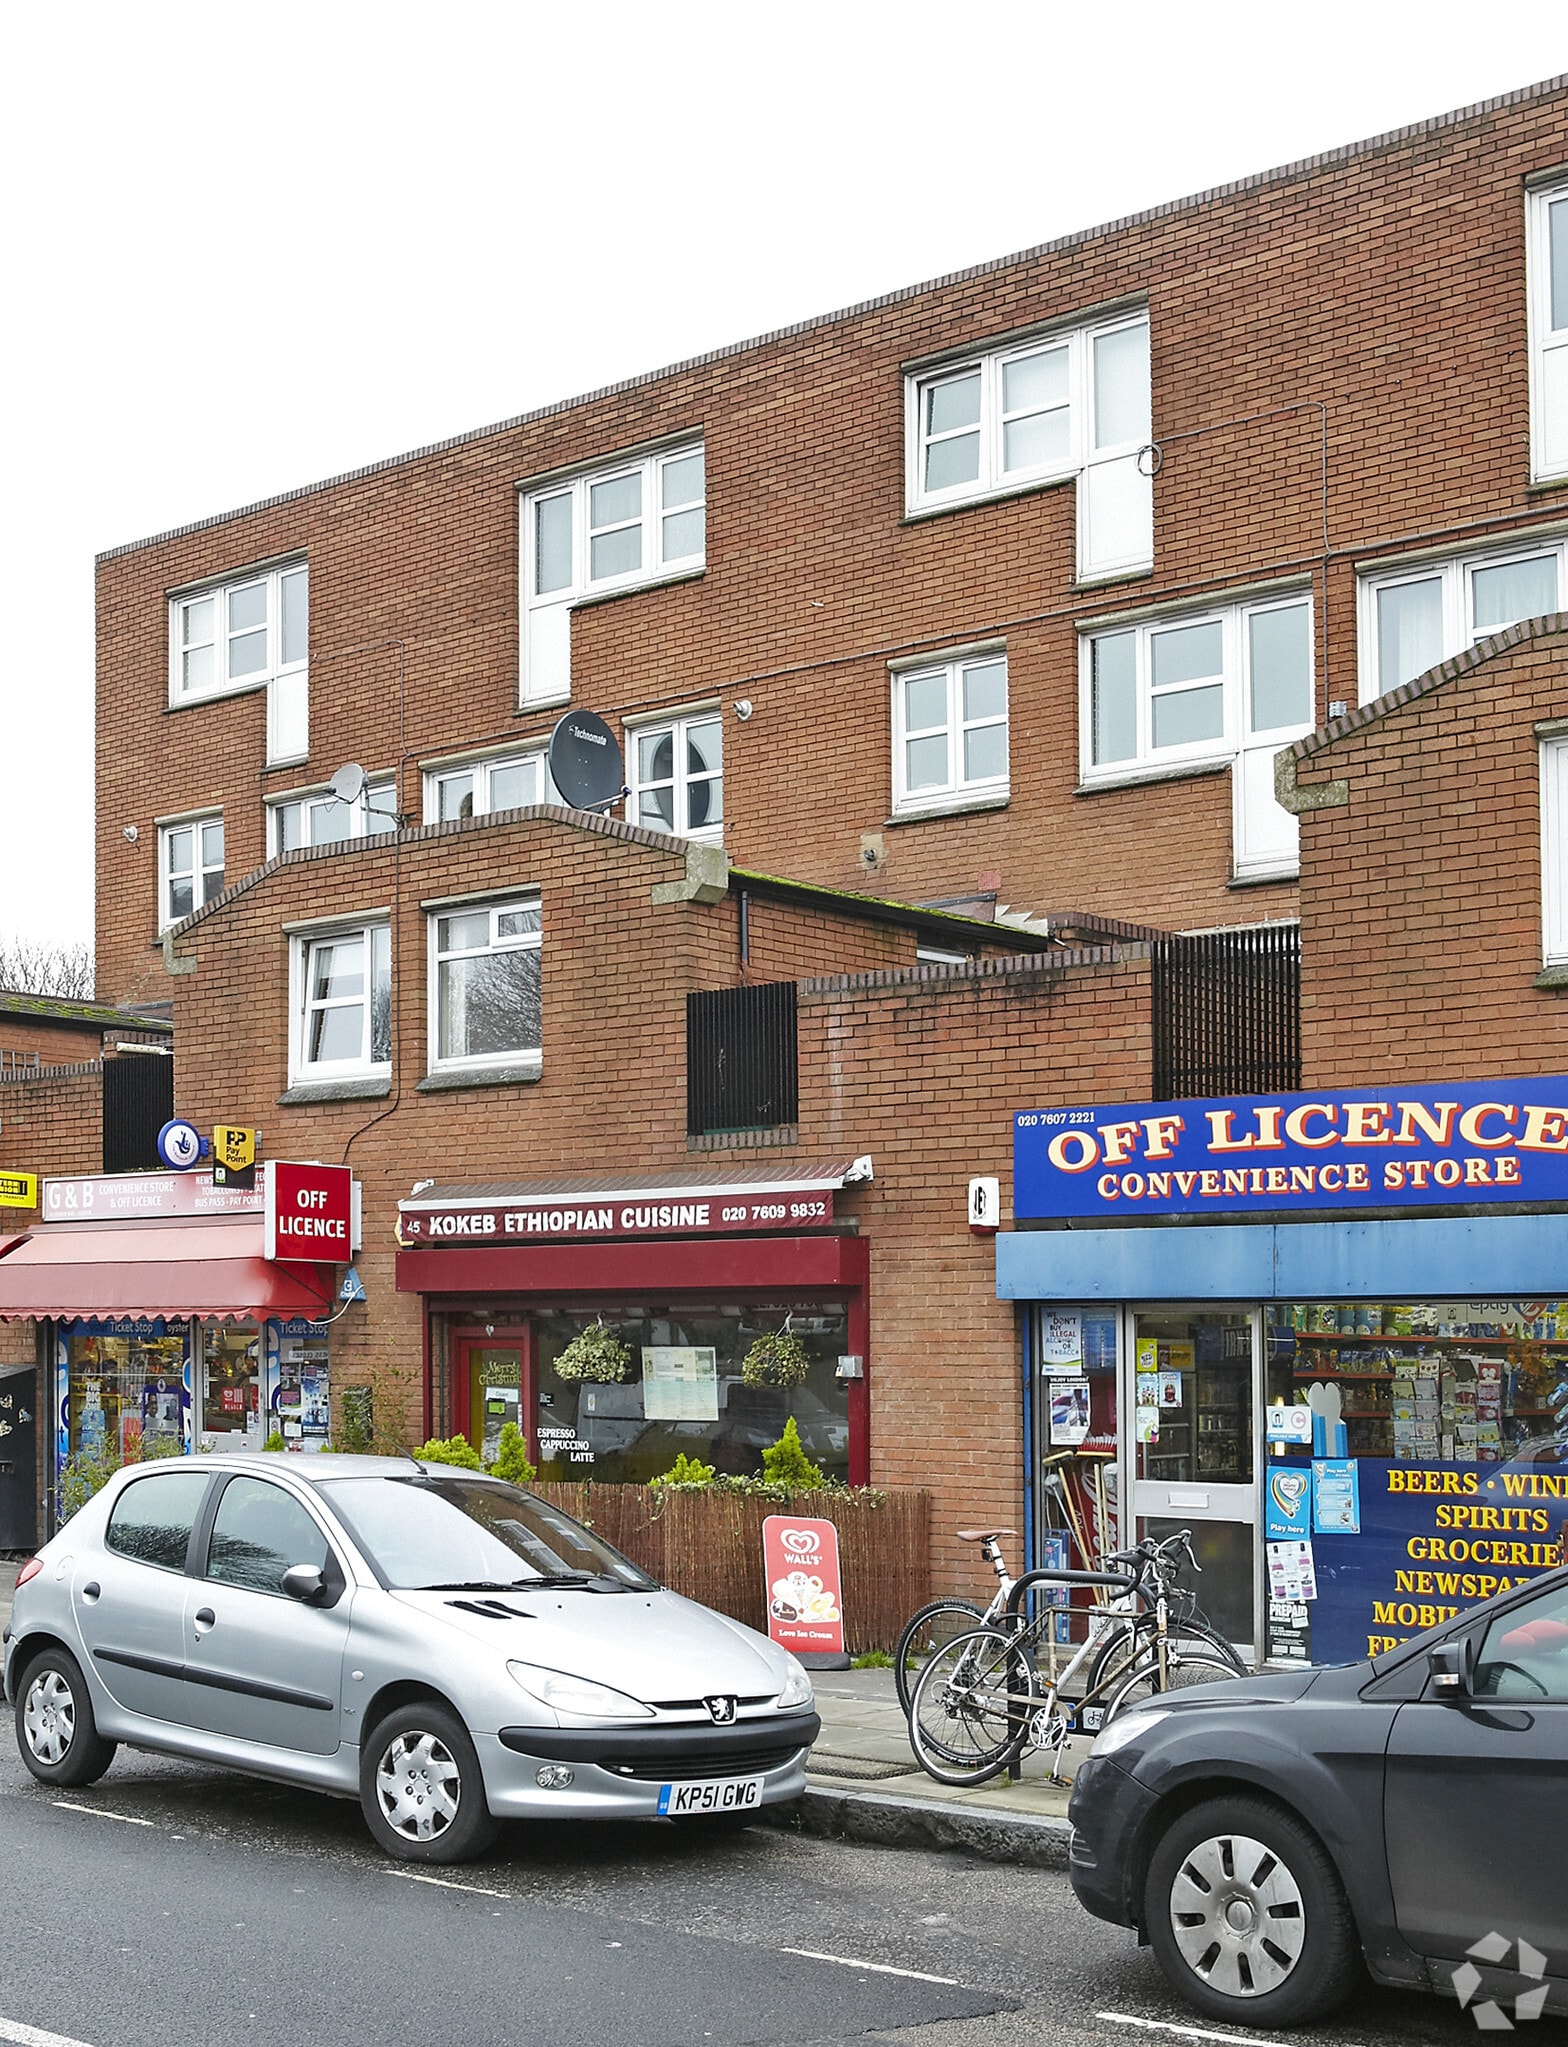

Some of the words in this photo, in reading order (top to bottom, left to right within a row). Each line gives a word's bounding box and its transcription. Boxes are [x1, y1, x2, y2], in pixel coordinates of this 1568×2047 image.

[1017, 1114, 1038, 1127] 020
[1040, 1113, 1067, 1126] 7607
[1069, 1111, 1095, 1124] 2221
[1048, 1114, 1187, 1174] OFF
[1205, 1101, 1568, 1154] LICENCE
[225, 1146, 241, 1156] Pay
[225, 1154, 247, 1164] Point
[1097, 1163, 1371, 1201] CONVENIENCE
[1384, 1155, 1522, 1192] STORE
[48, 1182, 61, 1210] G
[65, 1182, 79, 1209] &
[82, 1181, 95, 1208] B
[99, 1182, 149, 1196] CONVENIENCE
[150, 1181, 174, 1194] STORE
[110, 1197, 116, 1208] &
[118, 1197, 131, 1208] OFF
[132, 1195, 162, 1207] LICENCE
[194, 1198, 208, 1208] BUS
[209, 1197, 225, 1207] PASS
[229, 1196, 241, 1206] PAY
[242, 1194, 263, 1205] POINT
[297, 1189, 328, 1209] OFF
[406, 1221, 421, 1234] 45
[429, 1214, 496, 1235] KOKEB
[504, 1208, 614, 1232] ETHIOPIAN
[620, 1204, 710, 1228] CUISINE
[722, 1206, 747, 1221] 020
[751, 1204, 786, 1220] 7609
[790, 1202, 826, 1218] 9832
[279, 1215, 346, 1238] LICENCE
[110, 1321, 134, 1333] Ticket
[135, 1321, 154, 1334] Stop
[1053, 1317, 1077, 1325] DON'T
[167, 1323, 190, 1336] oyster
[280, 1322, 307, 1334] Ticket
[309, 1322, 328, 1336] Stop
[1050, 1330, 1077, 1338] ILLEGAL
[537, 1428, 576, 1438] ESPRESSO
[540, 1440, 590, 1451] CAPPUCCINO
[570, 1452, 595, 1463] LATTE
[1387, 1469, 1479, 1495] BEERS
[1436, 1504, 1550, 1532] SPIRITS
[1270, 1523, 1287, 1535] Play
[1287, 1524, 1305, 1534] here
[784, 1553, 820, 1565] WALL'S
[1407, 1536, 1565, 1568] GROCERIE
[1394, 1569, 1531, 1599] NEWSPA
[1269, 1604, 1308, 1618] PREPAID
[779, 1629, 796, 1638] Love
[797, 1630, 808, 1638] Ice
[809, 1630, 833, 1639] Cream
[675, 1785, 720, 1811] KP51
[722, 1782, 757, 1807] GWG
